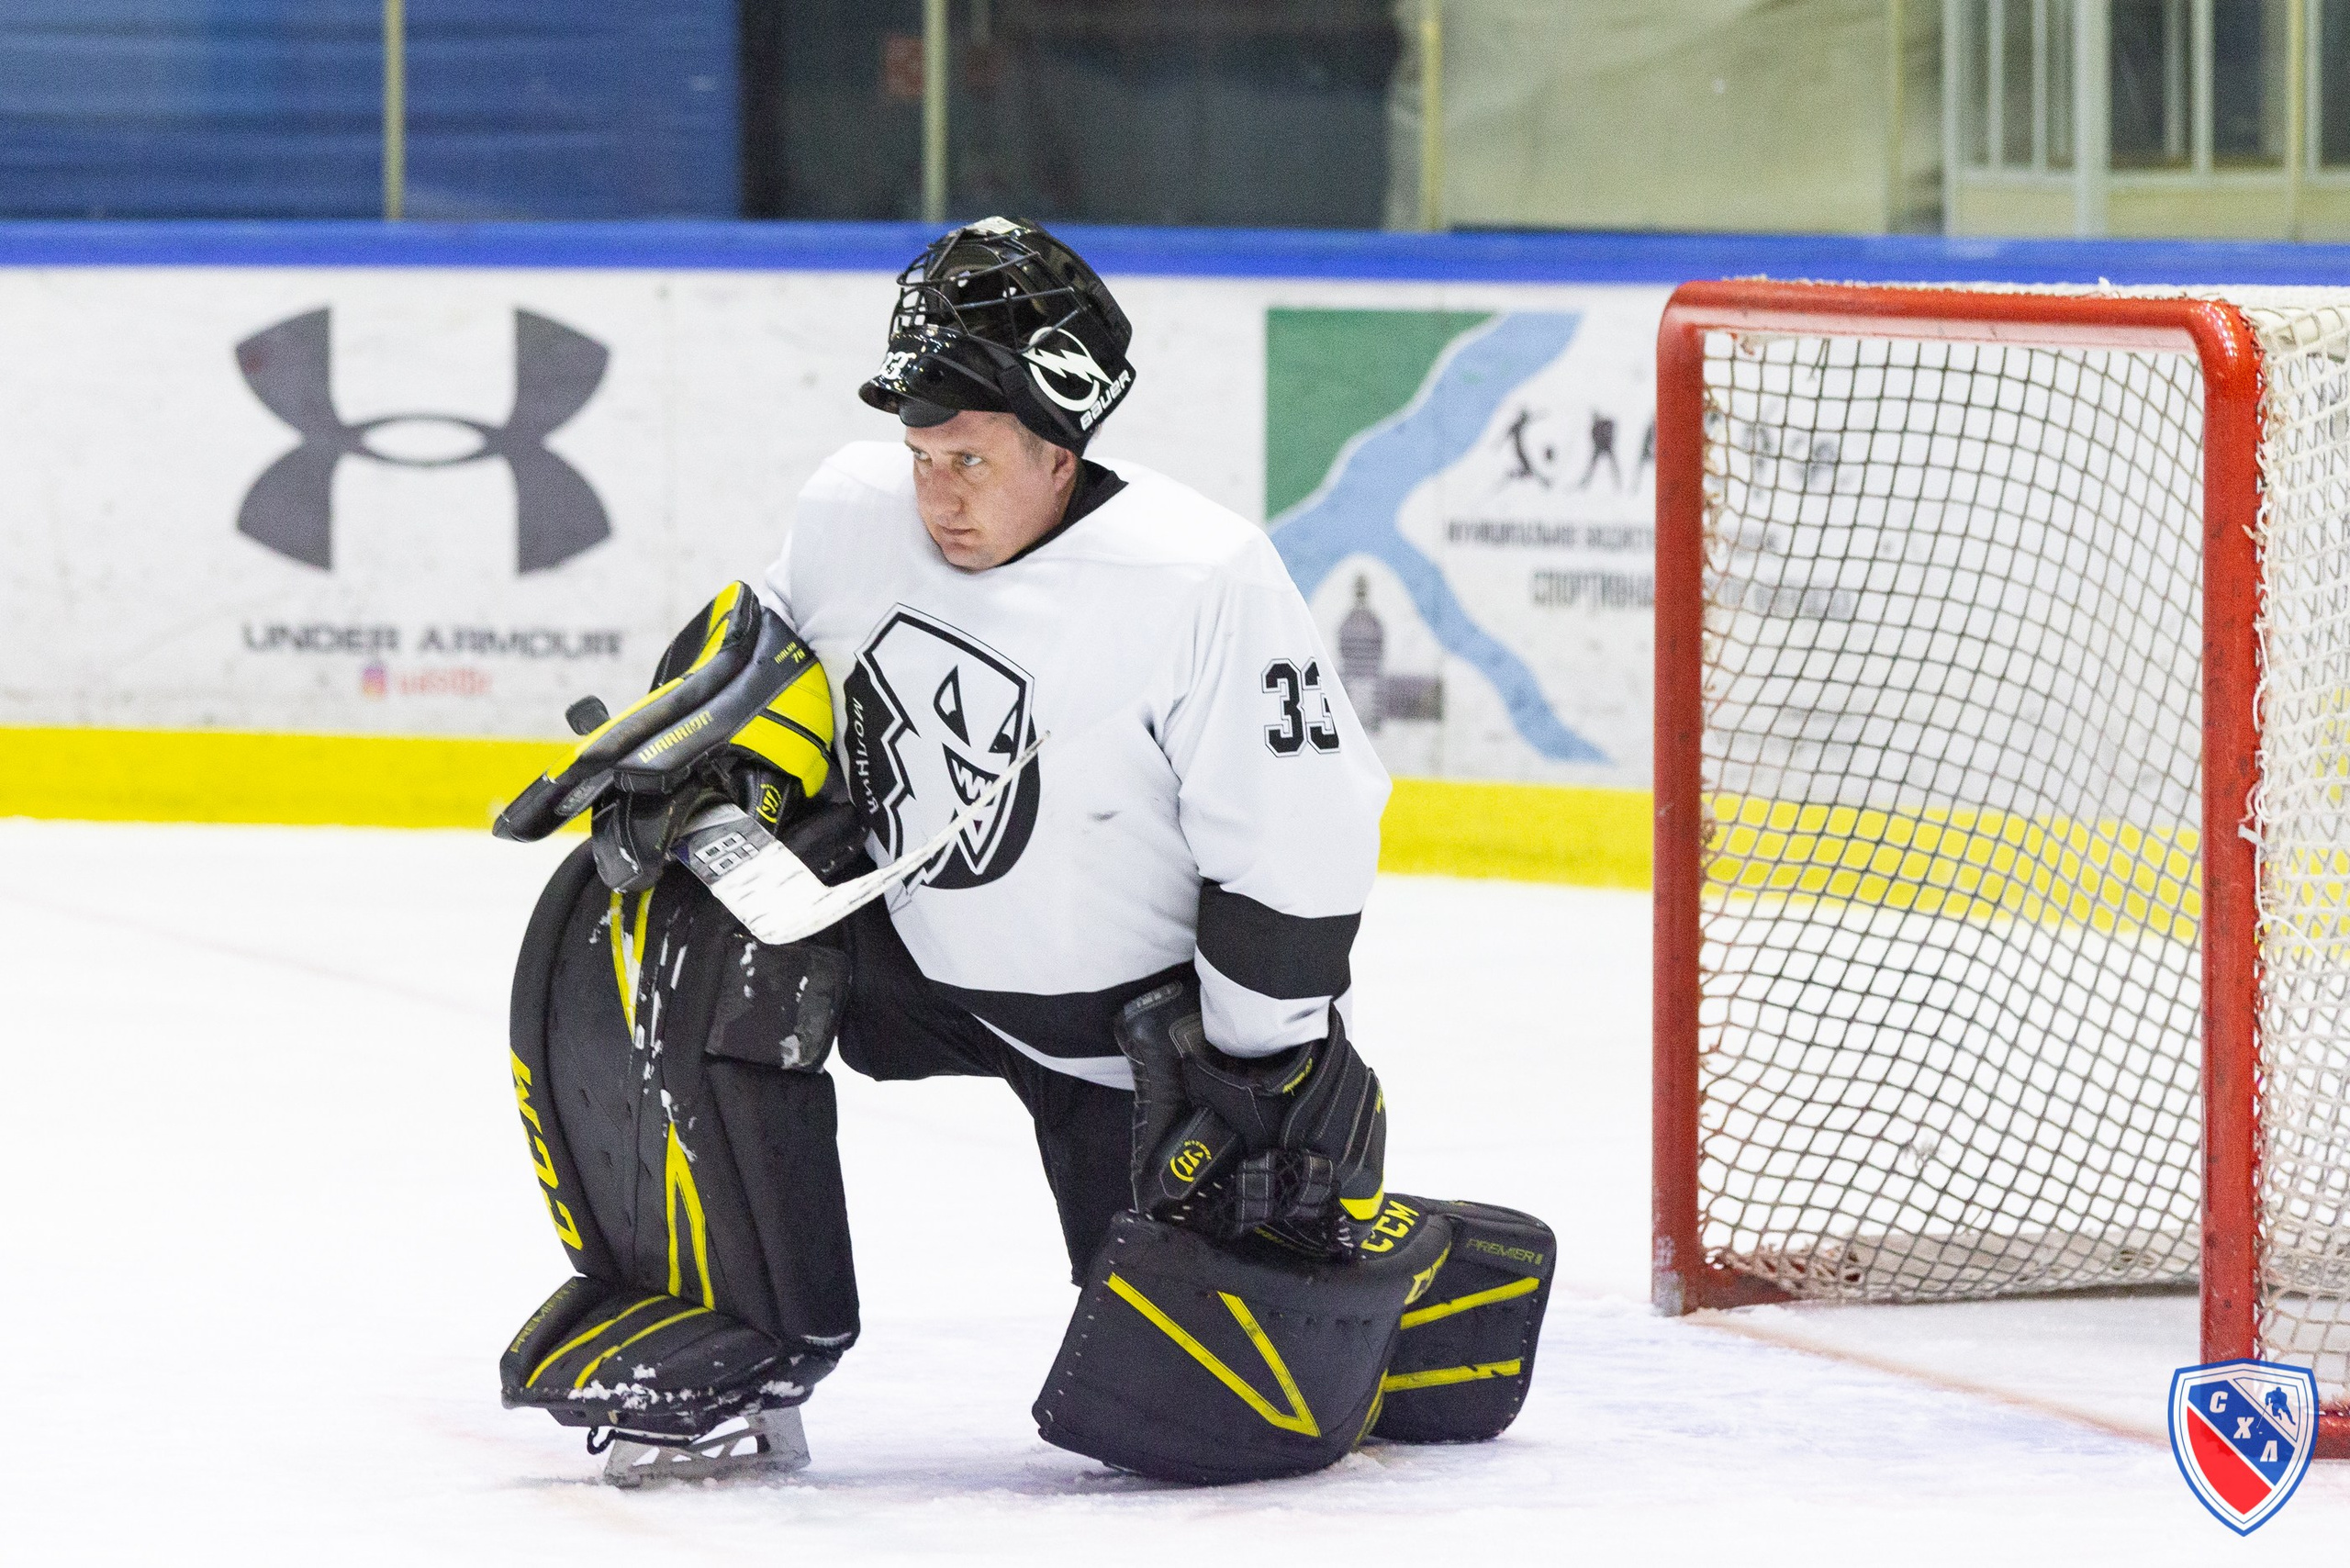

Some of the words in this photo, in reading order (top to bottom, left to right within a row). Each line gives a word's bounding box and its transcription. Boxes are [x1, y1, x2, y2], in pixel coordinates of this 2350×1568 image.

[1080, 370, 1131, 431] BAUER
[241, 622, 401, 655] UNDER
[419, 624, 625, 659] ARMOUR
[510, 1047, 583, 1251] CCM
[1360, 1200, 1420, 1253] CCM
